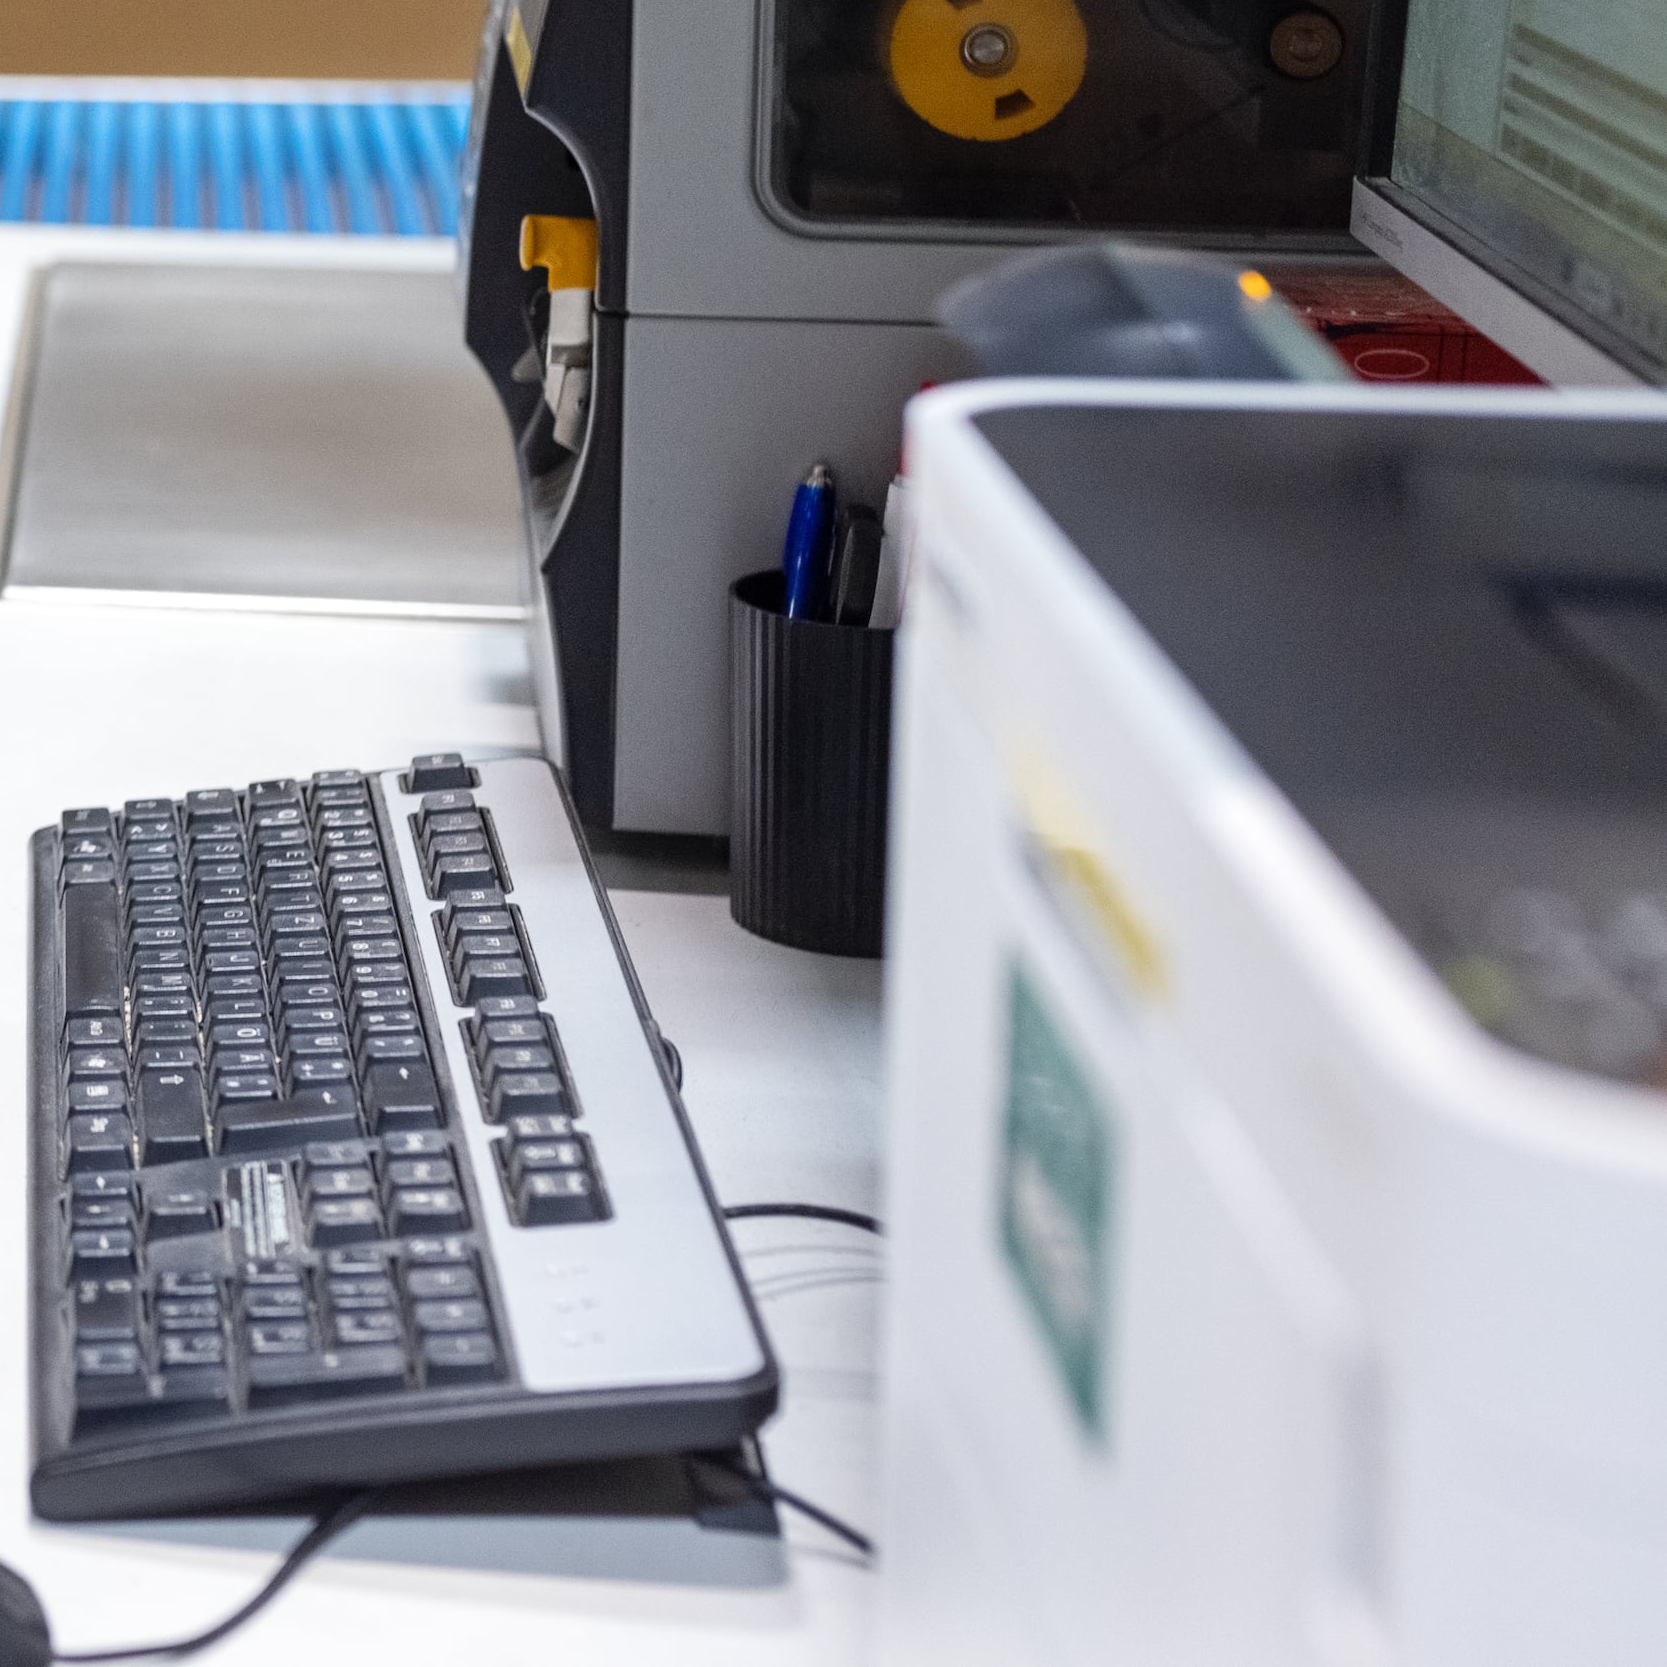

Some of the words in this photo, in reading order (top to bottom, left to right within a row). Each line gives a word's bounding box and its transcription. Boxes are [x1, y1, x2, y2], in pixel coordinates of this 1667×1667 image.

[215, 844, 234, 852] S
[286, 851, 305, 859] E
[217, 866, 237, 874] D
[220, 887, 240, 895] F
[291, 894, 310, 902] T
[341, 896, 358, 905] 6
[224, 909, 244, 918] G
[295, 916, 314, 925] Z
[346, 918, 363, 927] 7
[156, 929, 176, 937] B
[226, 931, 247, 939] H
[299, 940, 318, 948] U
[159, 952, 179, 961] N
[234, 1002, 255, 1010] L
[312, 1011, 334, 1020] P
